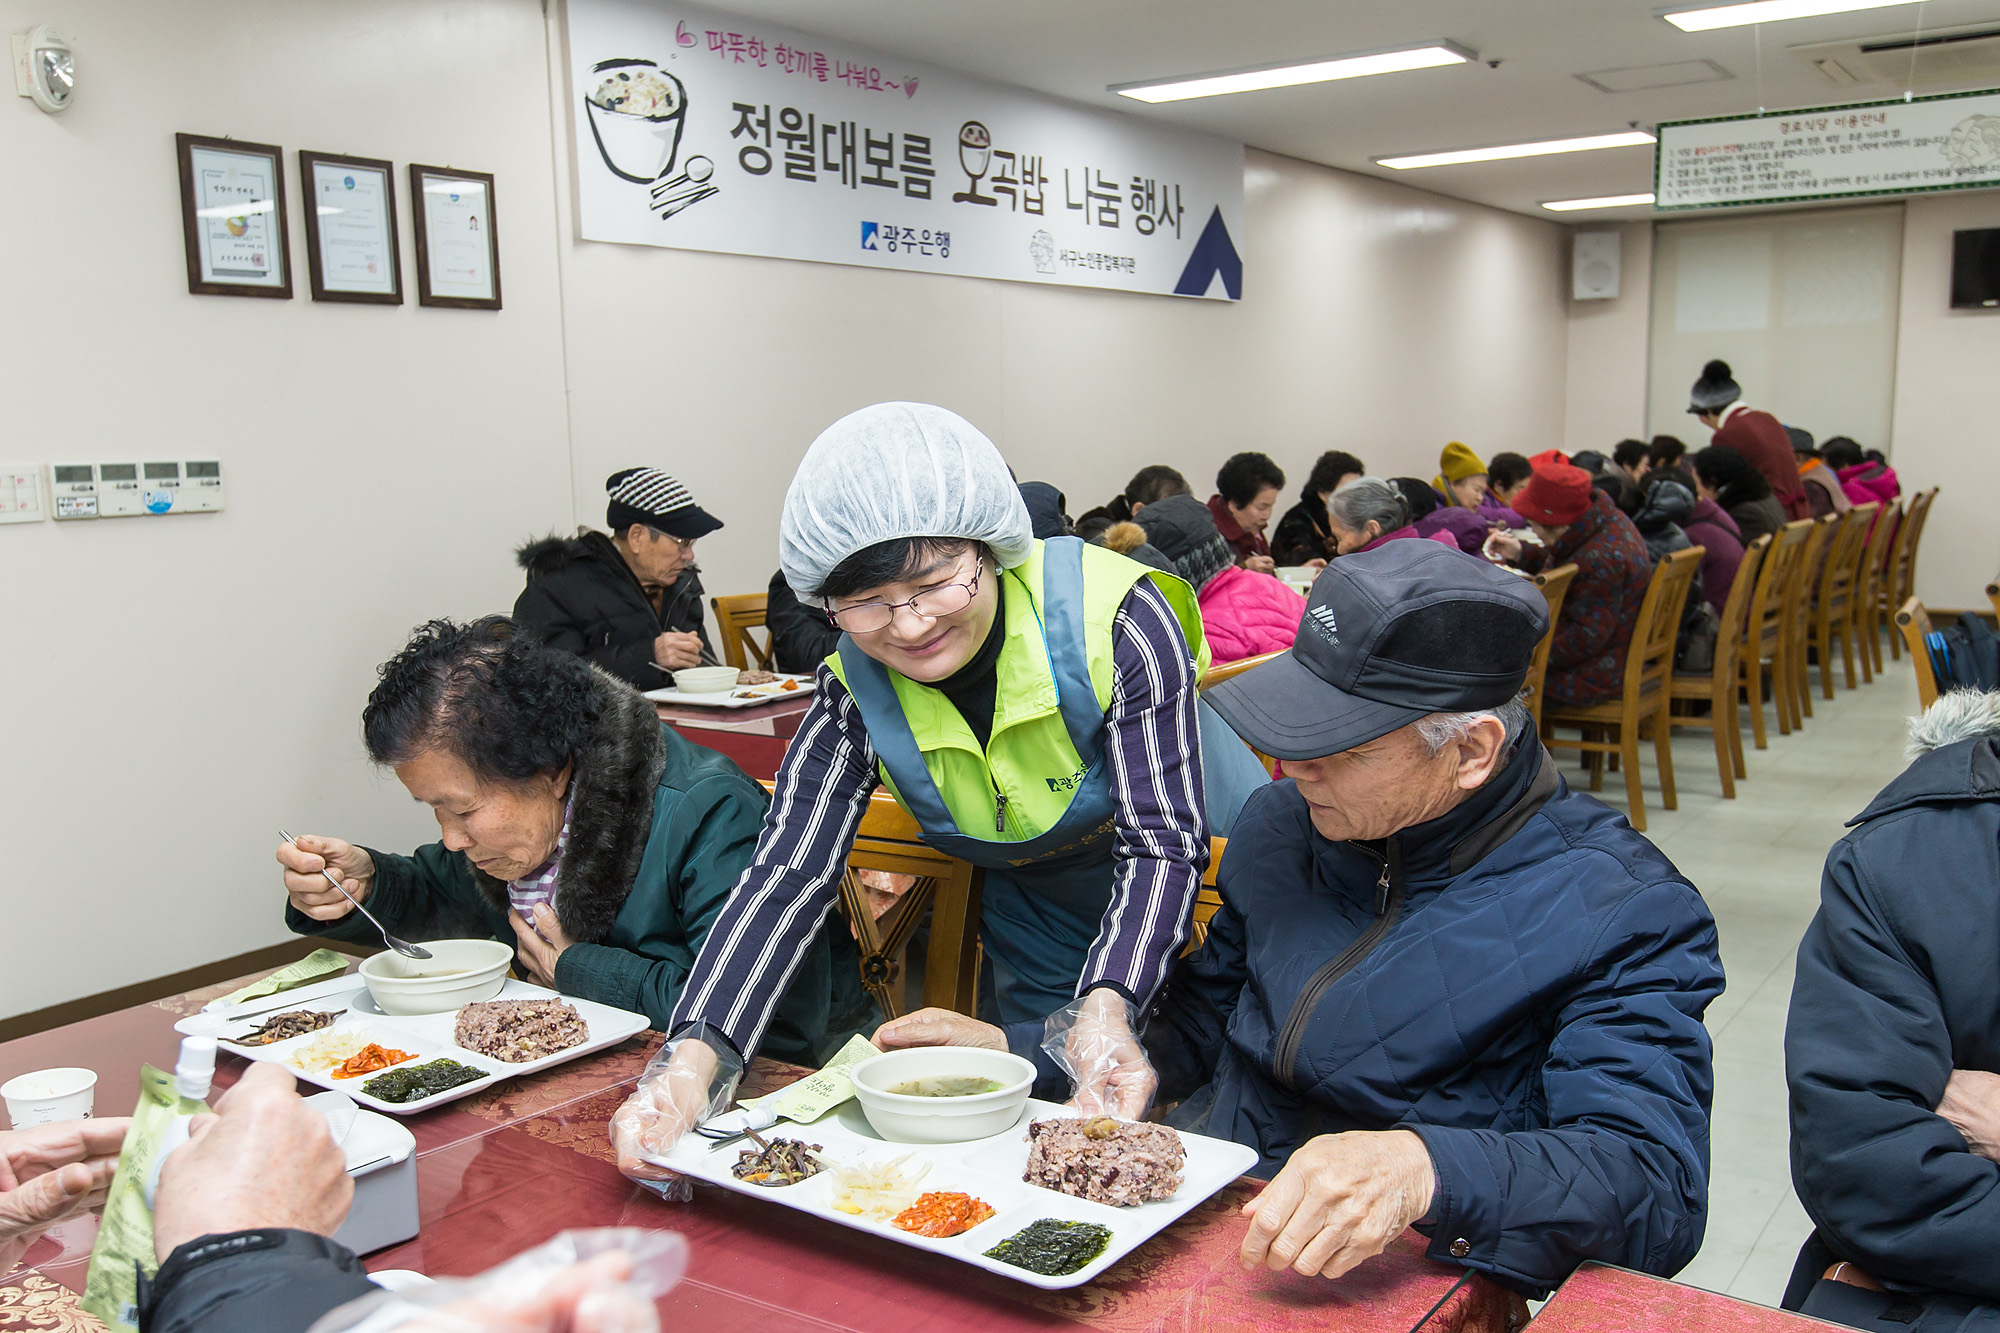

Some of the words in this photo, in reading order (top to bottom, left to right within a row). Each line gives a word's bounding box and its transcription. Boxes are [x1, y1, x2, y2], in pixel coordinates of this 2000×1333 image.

[774, 43, 830, 82] 한끼를
[1779, 118, 1829, 135] 경로식당
[1834, 111, 1887, 129] 이용안내
[730, 102, 936, 200] 정월대보름
[952, 119, 1048, 216] 오곡밥
[1065, 166, 1122, 229] 나눔
[1130, 174, 1184, 240] 행사
[882, 224, 951, 259] 광주은행
[1059, 249, 1135, 275] 서구노인종합복지관
[1058, 762, 1089, 790] 광주은
